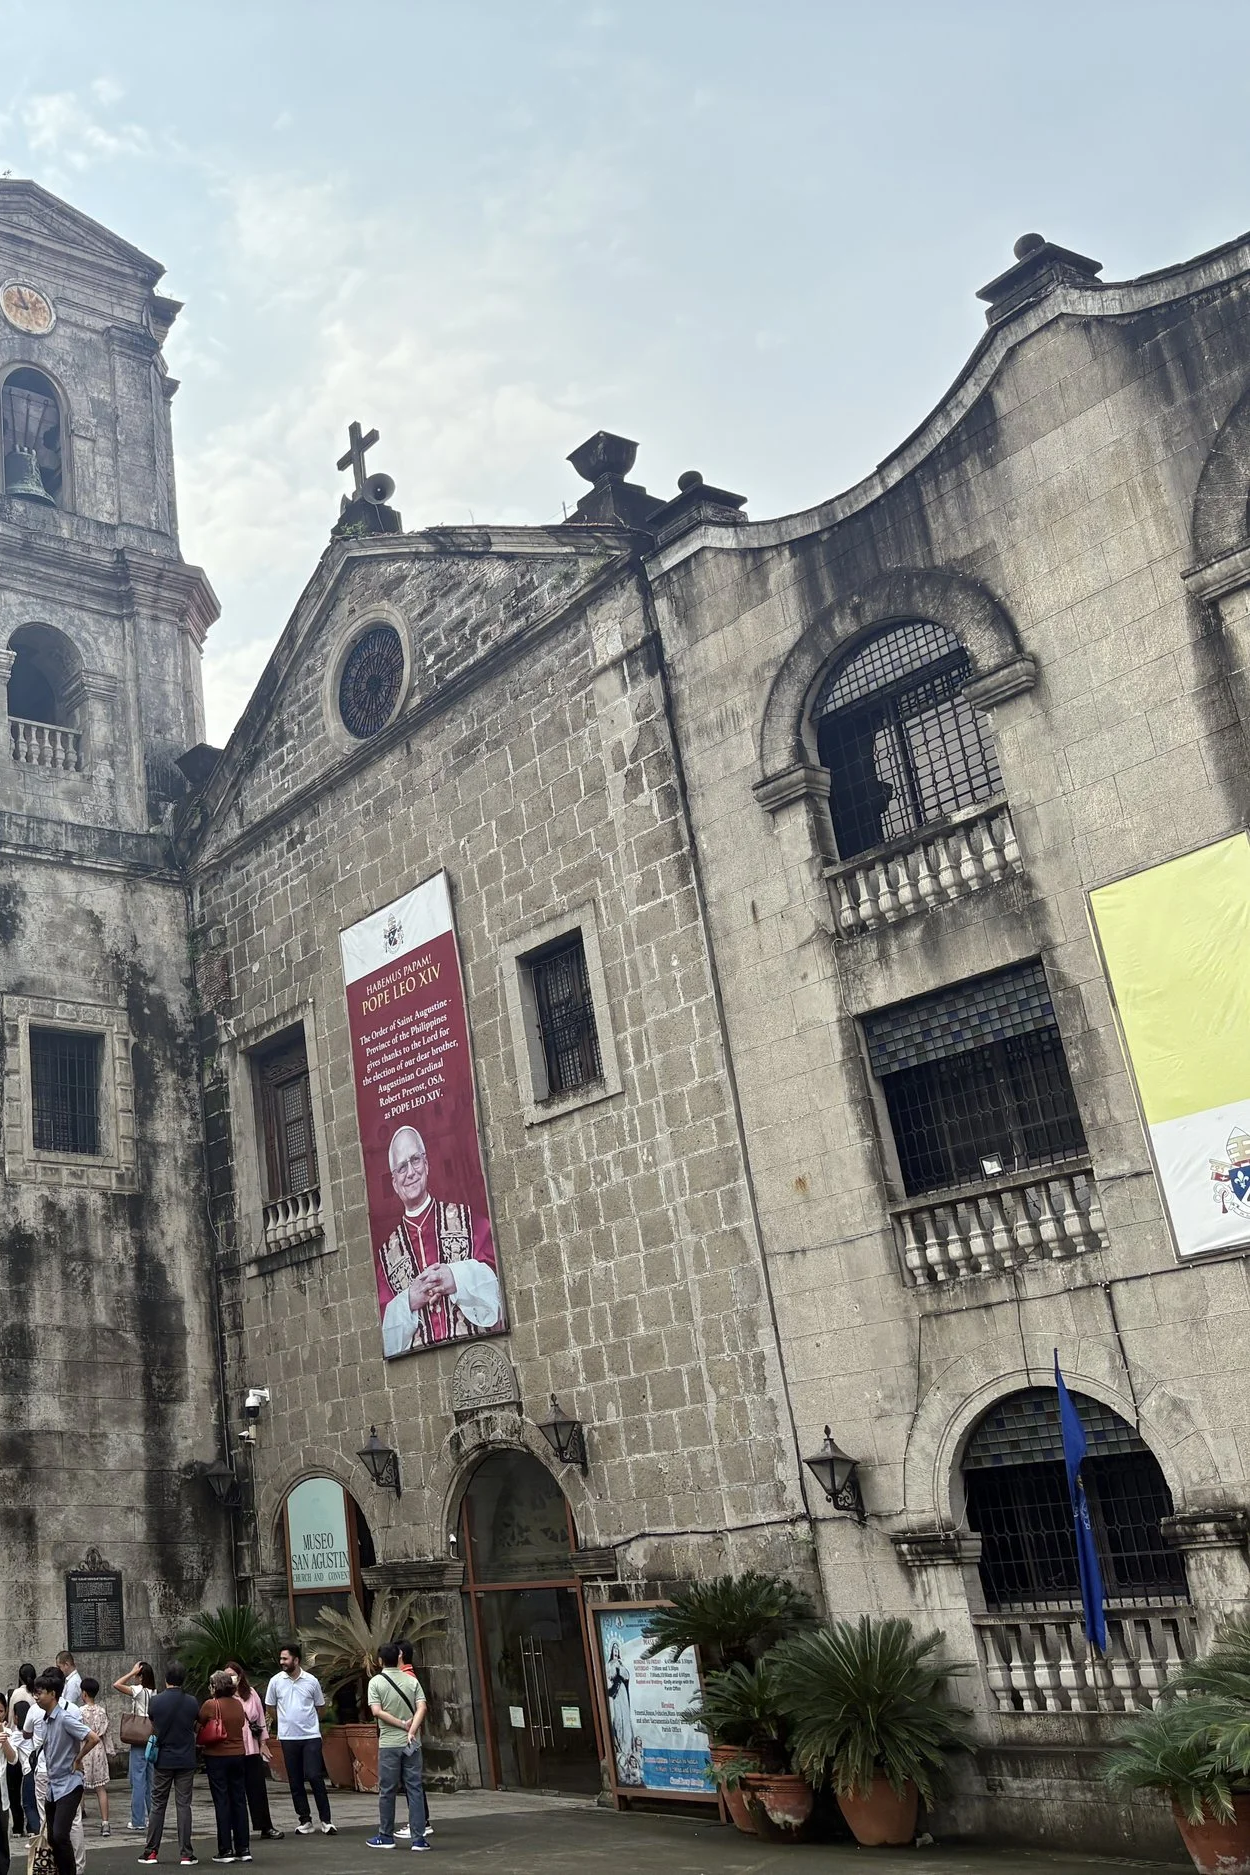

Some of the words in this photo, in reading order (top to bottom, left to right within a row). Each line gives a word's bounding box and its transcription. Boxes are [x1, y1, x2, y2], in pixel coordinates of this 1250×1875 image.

[362, 989, 390, 1016] POPE
[393, 976, 416, 1000] LEO
[419, 963, 441, 987] XIV
[366, 969, 402, 995] HABEMUS
[403, 953, 432, 977] PAPAM!
[360, 1035, 371, 1045] The
[371, 1026, 388, 1040] Order
[390, 1020, 397, 1033] of
[396, 1016, 413, 1028] Saint
[414, 1000, 448, 1019] Augustine
[365, 1041, 390, 1056] Province
[392, 1035, 399, 1045] of
[399, 1032, 410, 1041] the
[410, 1014, 447, 1036] Philippines
[362, 1077, 372, 1086] the
[373, 1068, 396, 1082] election
[396, 1060, 404, 1072] of
[404, 1058, 415, 1067] our
[416, 1051, 430, 1062] dear
[431, 1038, 459, 1056] brother,
[366, 1058, 381, 1074] gives
[381, 1046, 402, 1064] thanks
[403, 1044, 410, 1054] to
[411, 1040, 421, 1050] the
[422, 1033, 438, 1045] Lord
[439, 1027, 450, 1038] for
[378, 1073, 415, 1093] Augustinian
[416, 1057, 444, 1077] Cardinal
[379, 1093, 401, 1107] Robert
[402, 1083, 427, 1099] Prevost,
[427, 1073, 445, 1086] OSA,
[391, 1101, 410, 1117] POPE
[411, 1095, 426, 1109] LEO
[427, 1088, 443, 1103] XIV.
[303, 1533, 333, 1550] MUSEO
[292, 1554, 309, 1570] SAN
[311, 1551, 350, 1569] AGUSTIN
[314, 1572, 324, 1581] AND
[35, 1846, 54, 1859] HON
